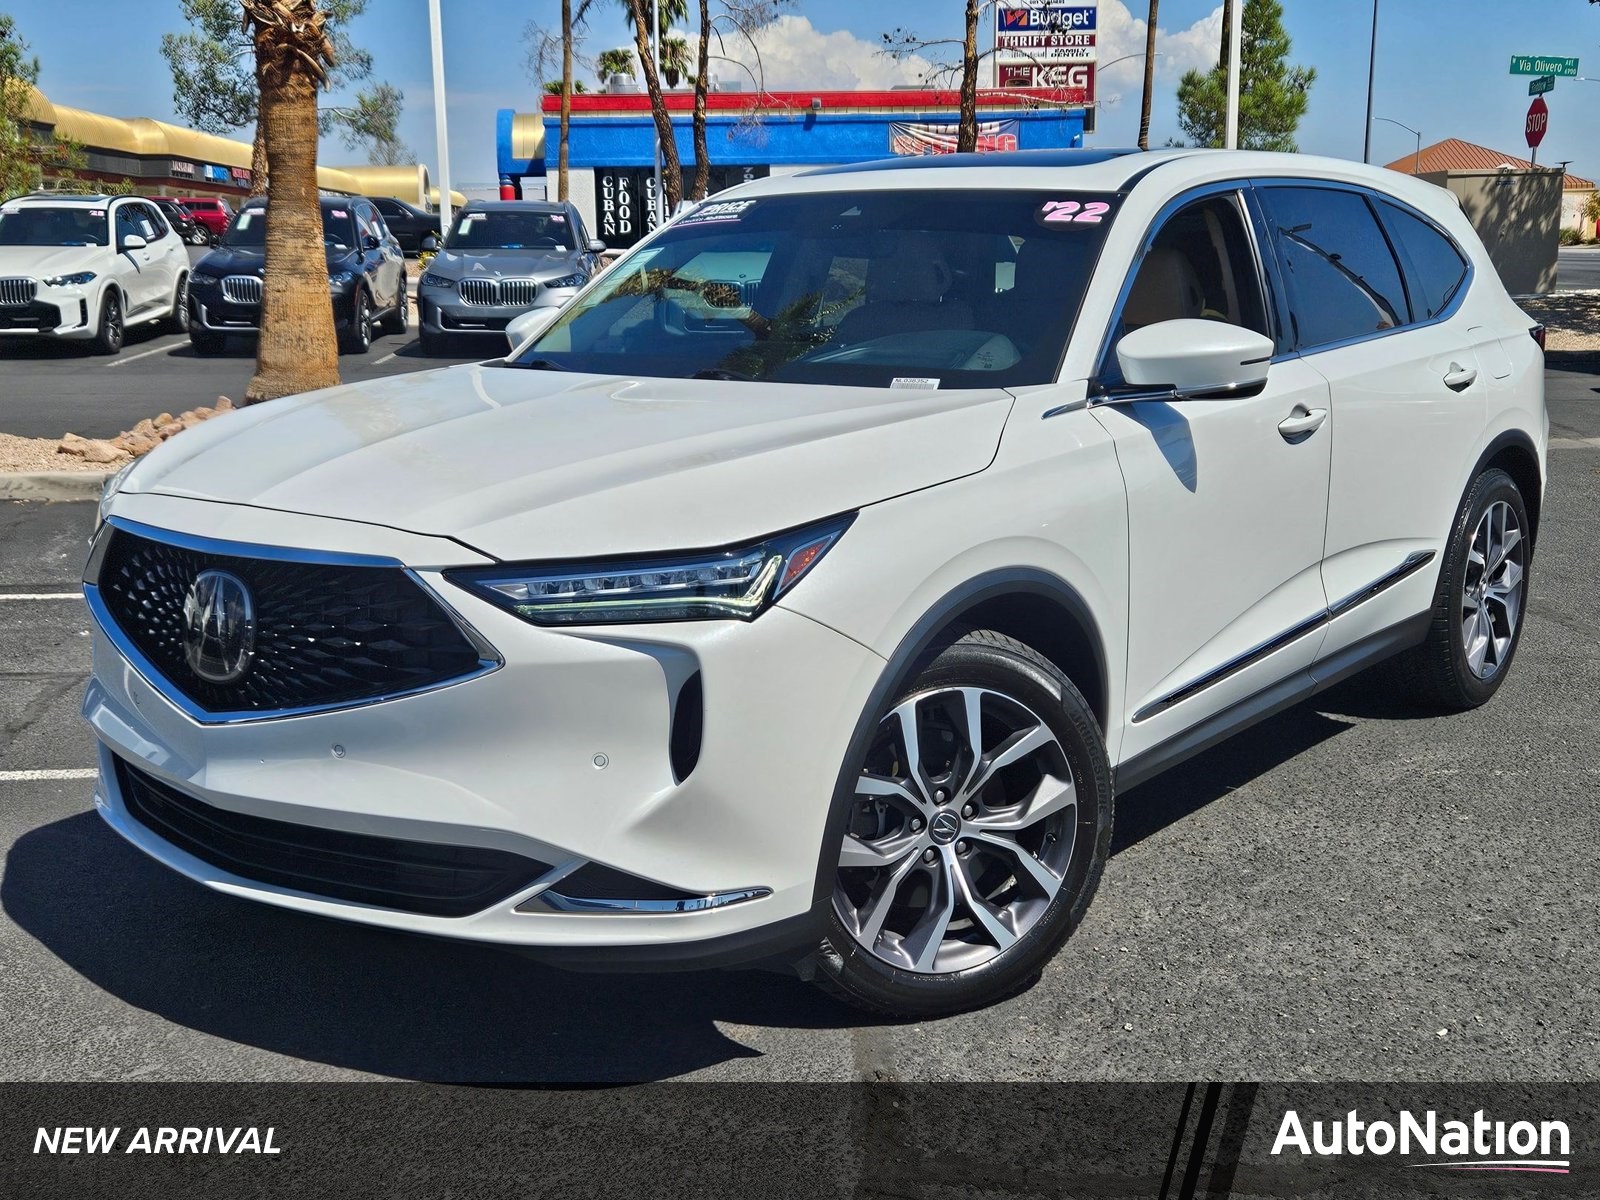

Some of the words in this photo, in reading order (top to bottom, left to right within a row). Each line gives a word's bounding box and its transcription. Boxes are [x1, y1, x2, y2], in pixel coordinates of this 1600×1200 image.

[1029, 9, 1089, 28] Budget
[1003, 35, 1046, 46] THRIFT
[1050, 35, 1090, 45] STORE
[1519, 59, 1531, 72] Via
[1534, 60, 1563, 73] Olivero
[1005, 67, 1031, 77] THE
[1032, 66, 1088, 88] KEG
[1527, 112, 1546, 132] STOP
[602, 176, 616, 236] CUBAN
[618, 177, 632, 234] FOOD
[646, 177, 657, 233] CUBAN
[1042, 201, 1110, 222] '22
